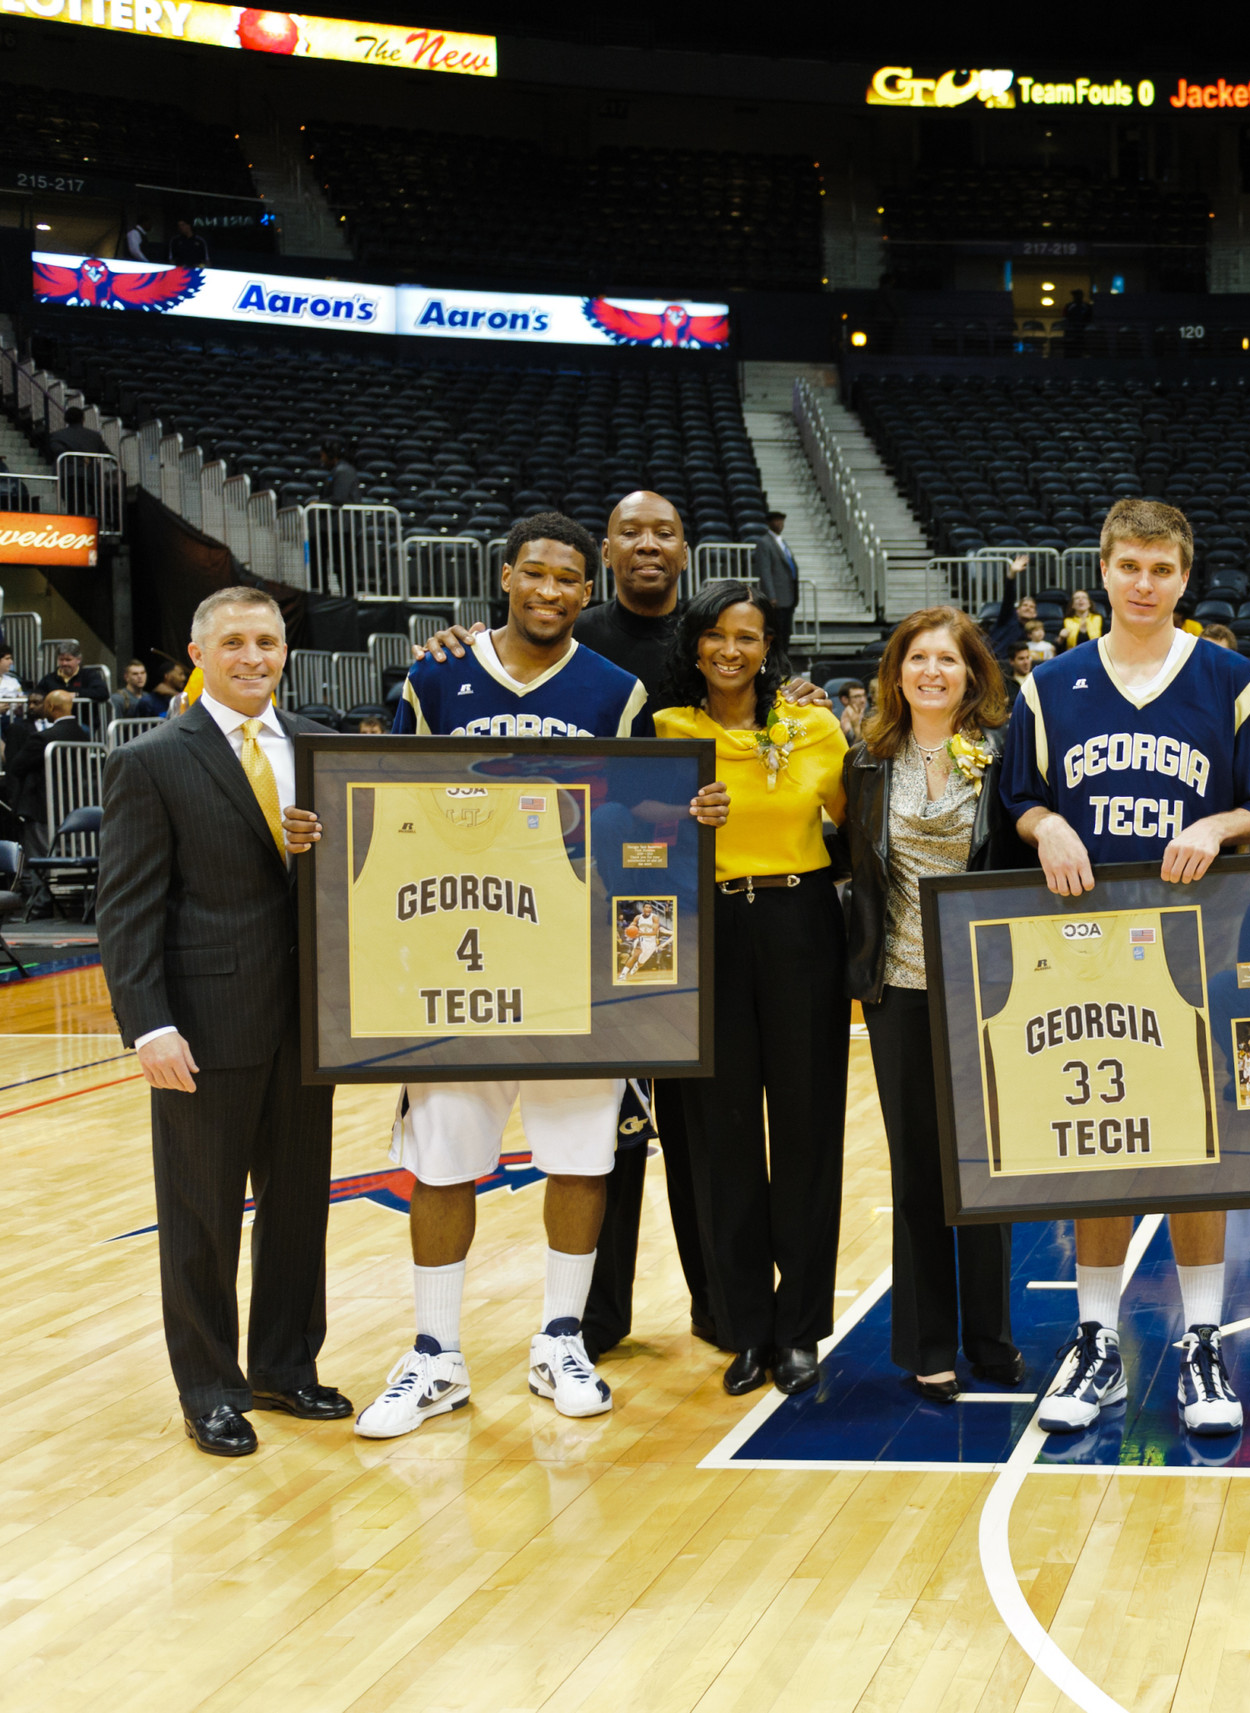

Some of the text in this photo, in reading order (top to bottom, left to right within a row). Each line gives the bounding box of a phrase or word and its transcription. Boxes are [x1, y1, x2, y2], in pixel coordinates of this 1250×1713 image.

[355, 30, 490, 70] The New
[1138, 80, 1155, 106] 0
[17, 173, 84, 192] 215-217
[237, 284, 374, 320] Aaron's
[419, 302, 549, 331] Aaron's
[1179, 325, 1205, 338] 120
[450, 714, 595, 737] EORG
[1063, 732, 1211, 797] GEORGIA
[1089, 795, 1184, 838] TECH
[396, 874, 539, 925] GEORGIA
[455, 927, 484, 972] 4
[419, 988, 524, 1025] TECH
[1025, 1002, 1165, 1055] GEORGIA
[1061, 1057, 1126, 1106] 33
[1051, 1117, 1151, 1158] TECH
